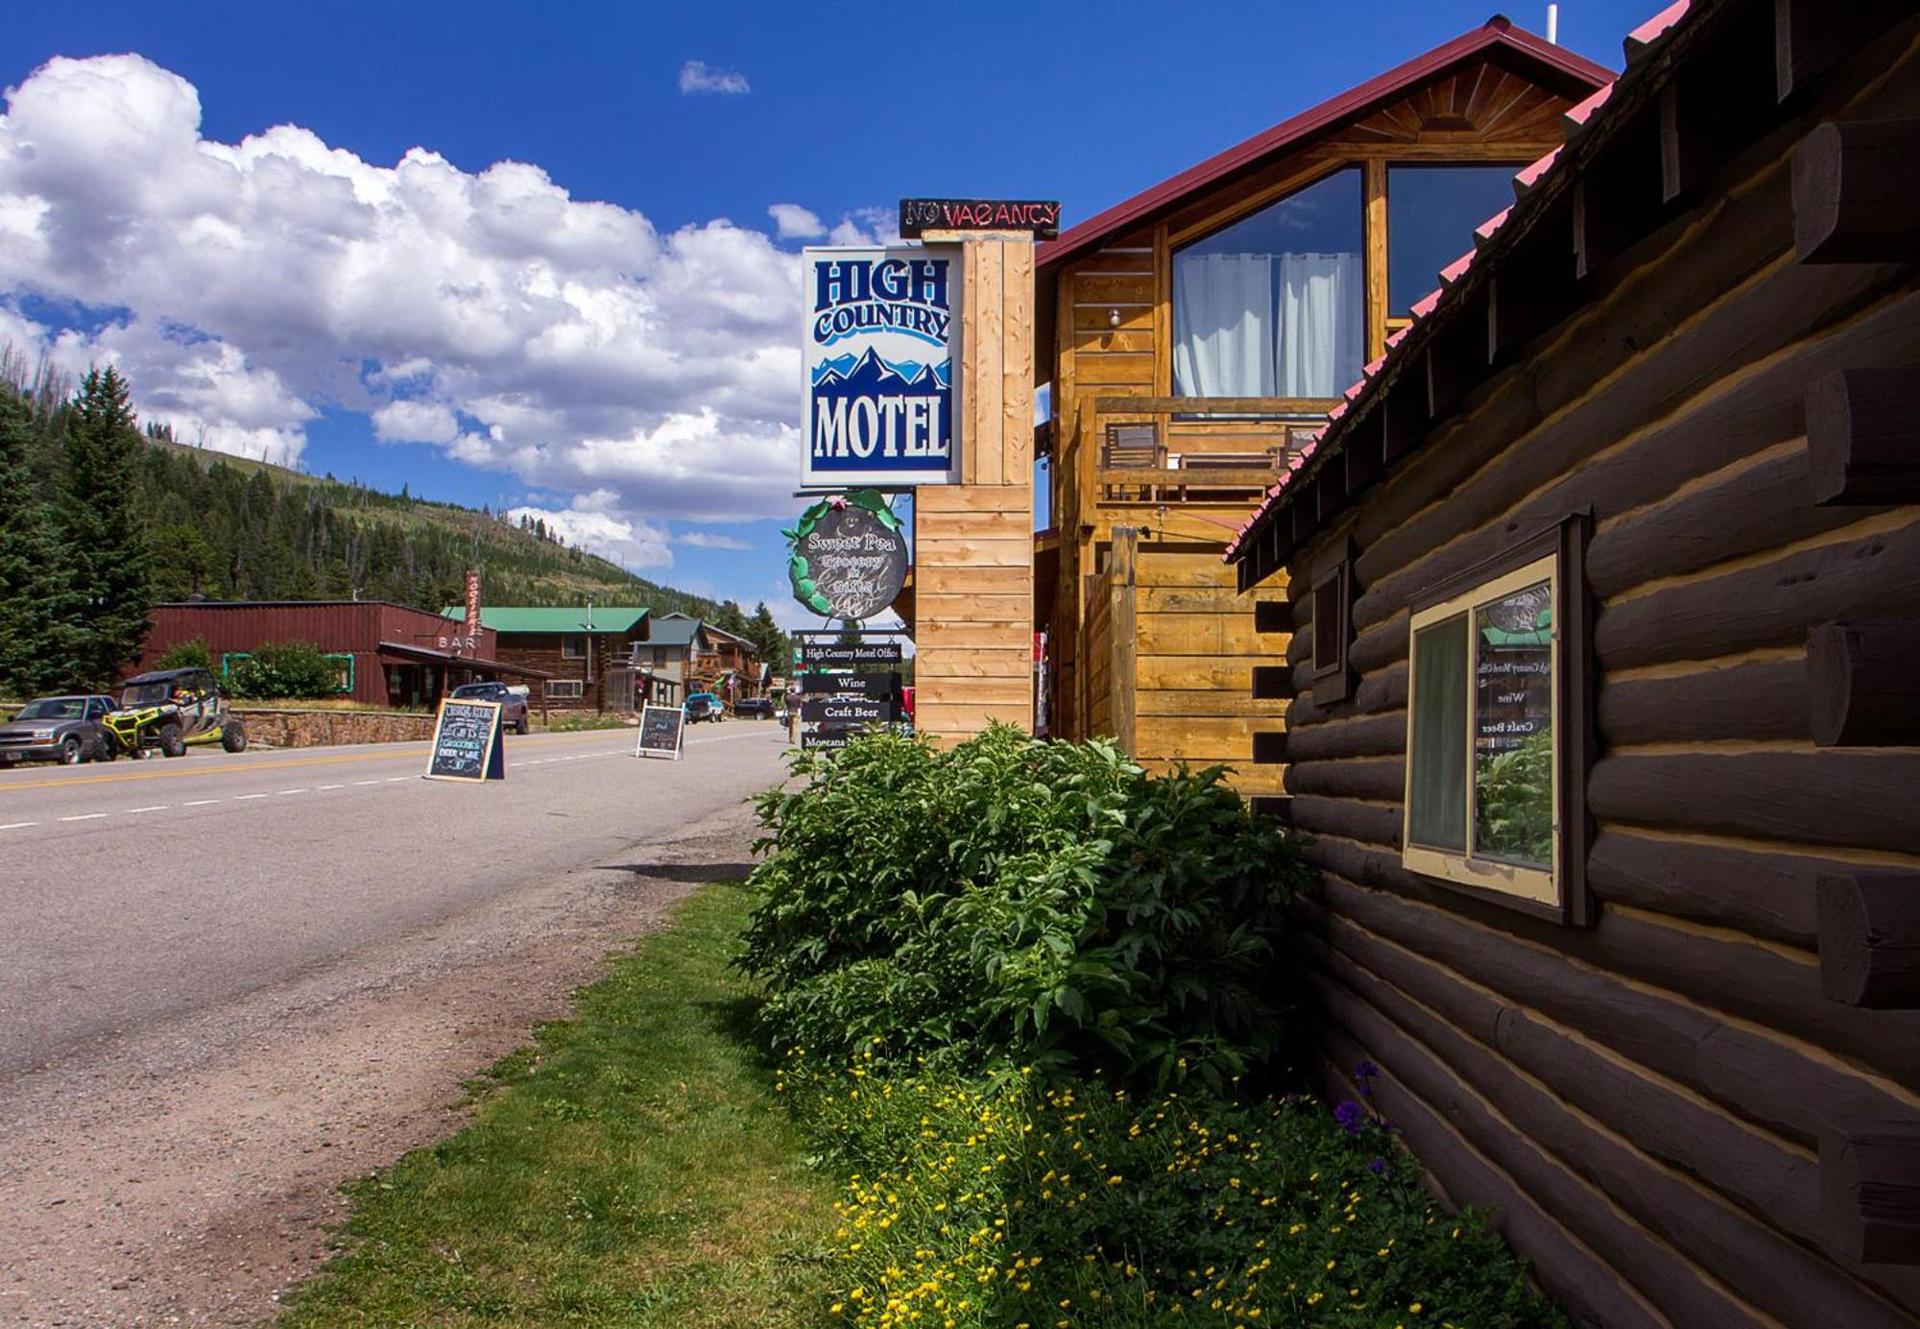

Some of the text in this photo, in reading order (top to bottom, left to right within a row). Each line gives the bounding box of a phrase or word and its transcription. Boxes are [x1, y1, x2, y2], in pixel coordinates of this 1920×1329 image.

[905, 202, 1062, 226] NO VACANCY
[814, 259, 949, 313] HIGH
[813, 304, 951, 343] COUNTRY
[813, 397, 949, 458] MOTEL
[808, 532, 896, 552] Sweet Pea
[439, 637, 476, 649] BAR
[806, 648, 898, 660] High Country Motel Office
[838, 678, 866, 688] Wine
[825, 707, 878, 717] Craft Beer
